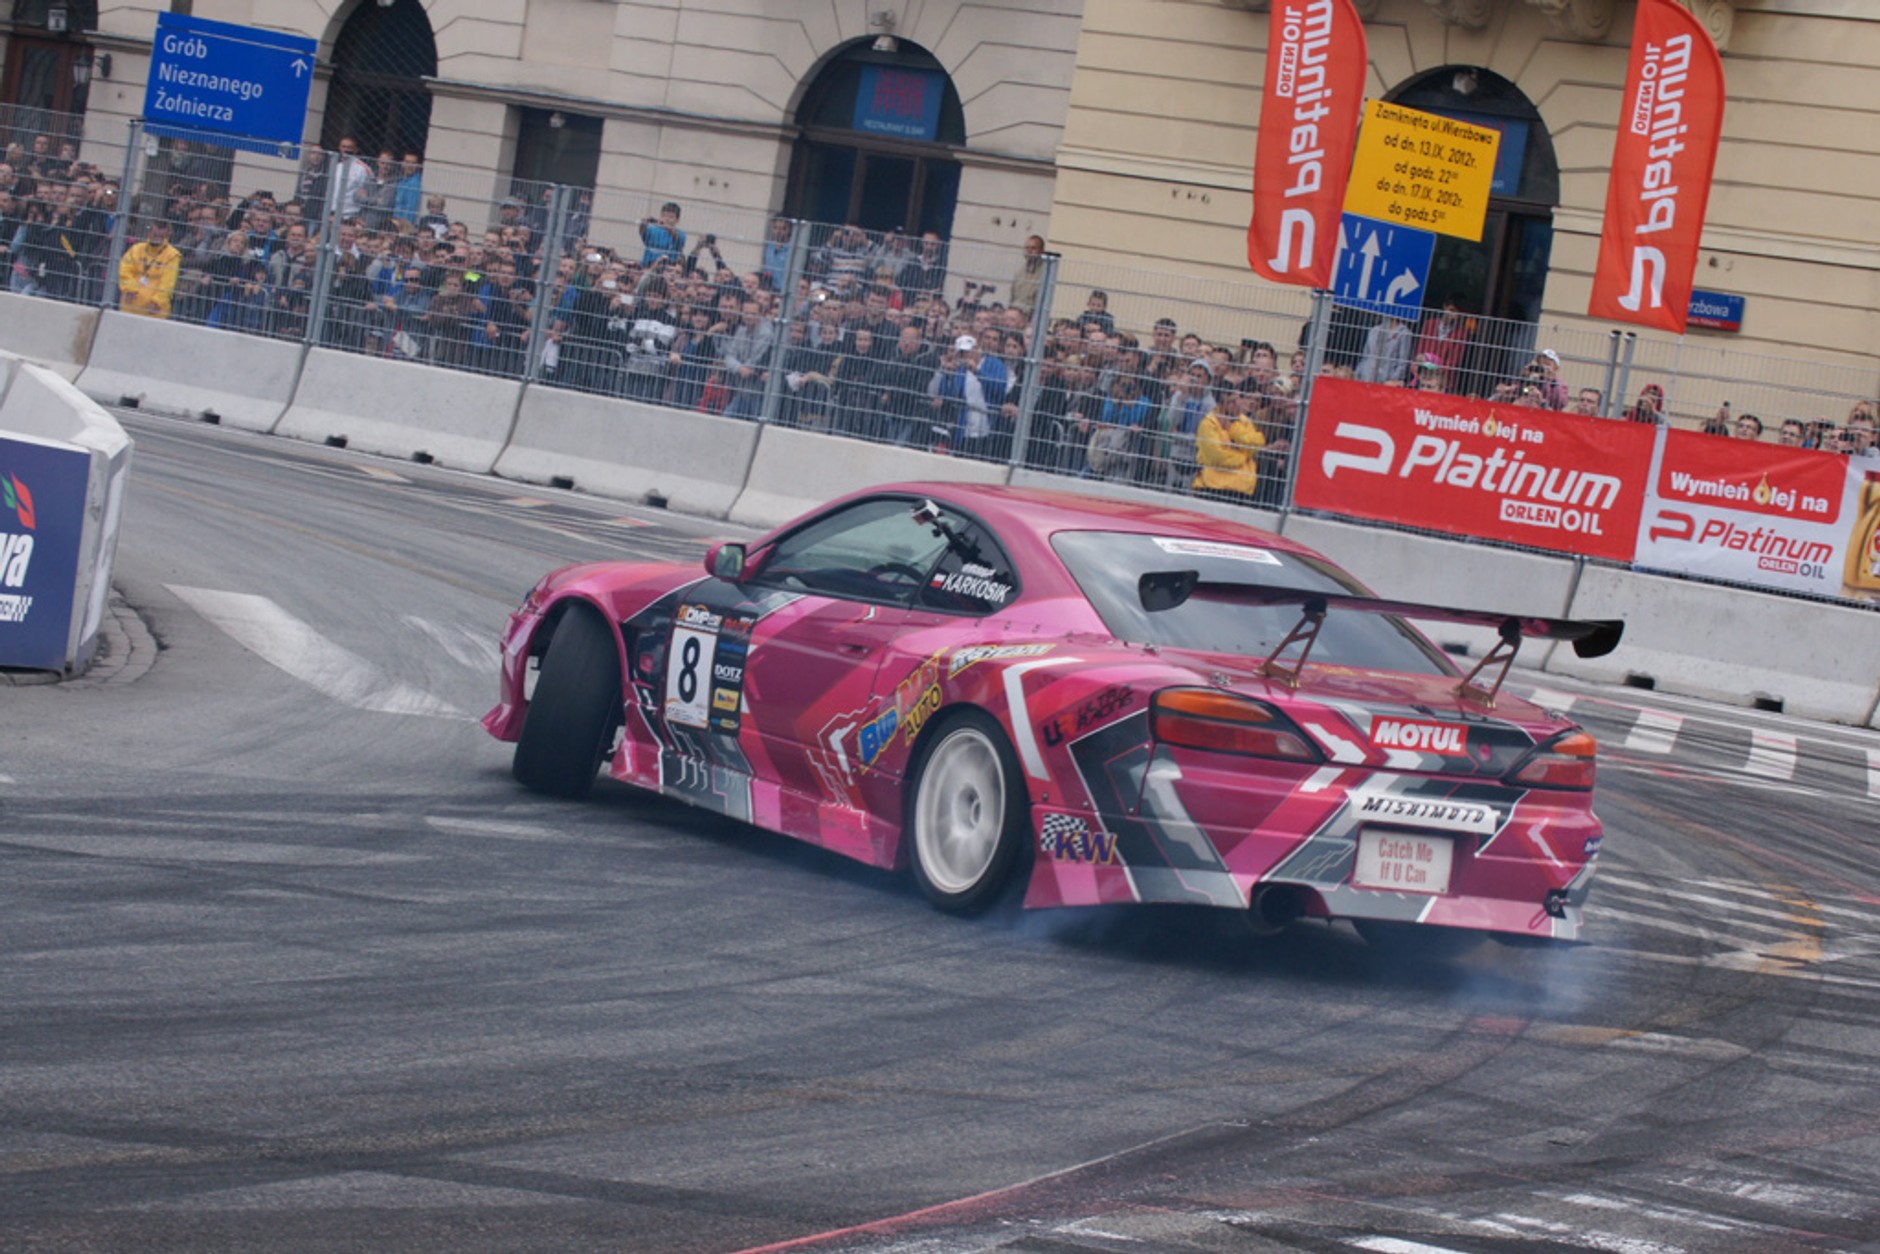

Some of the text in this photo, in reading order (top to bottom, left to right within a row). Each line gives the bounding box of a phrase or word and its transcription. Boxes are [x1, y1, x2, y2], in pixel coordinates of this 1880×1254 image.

[163, 34, 208, 59] Grób
[158, 62, 264, 101] Nieznanego
[154, 86, 234, 122] Żołnierza
[1375, 103, 1429, 130] Zamknięta
[1384, 133, 1398, 148] od
[1394, 161, 1408, 175] od
[1376, 178, 1390, 192] do
[1388, 201, 1402, 215] do
[1689, 300, 1729, 317] rzbowa
[1414, 408, 1479, 434] Wymień
[1521, 429, 1544, 444] na
[1400, 434, 1621, 510] Platinum
[1671, 471, 1749, 502] Wymień
[1801, 495, 1829, 513] na
[1504, 507, 1603, 536] ORLEN OIL
[1698, 519, 1833, 565] Platinum
[0, 532, 34, 588] va
[1760, 558, 1825, 580] ORLEN OIL
[942, 573, 1013, 603] KARKOSIK
[678, 636, 700, 705] 8
[715, 664, 743, 680] DOTZ
[1374, 721, 1462, 752] MOTUL
[1362, 797, 1486, 823] MISHIMOTO
[1055, 831, 1117, 863] KW
[1378, 838, 1433, 863] Catch Me
[1380, 861, 1426, 884] If U Can
